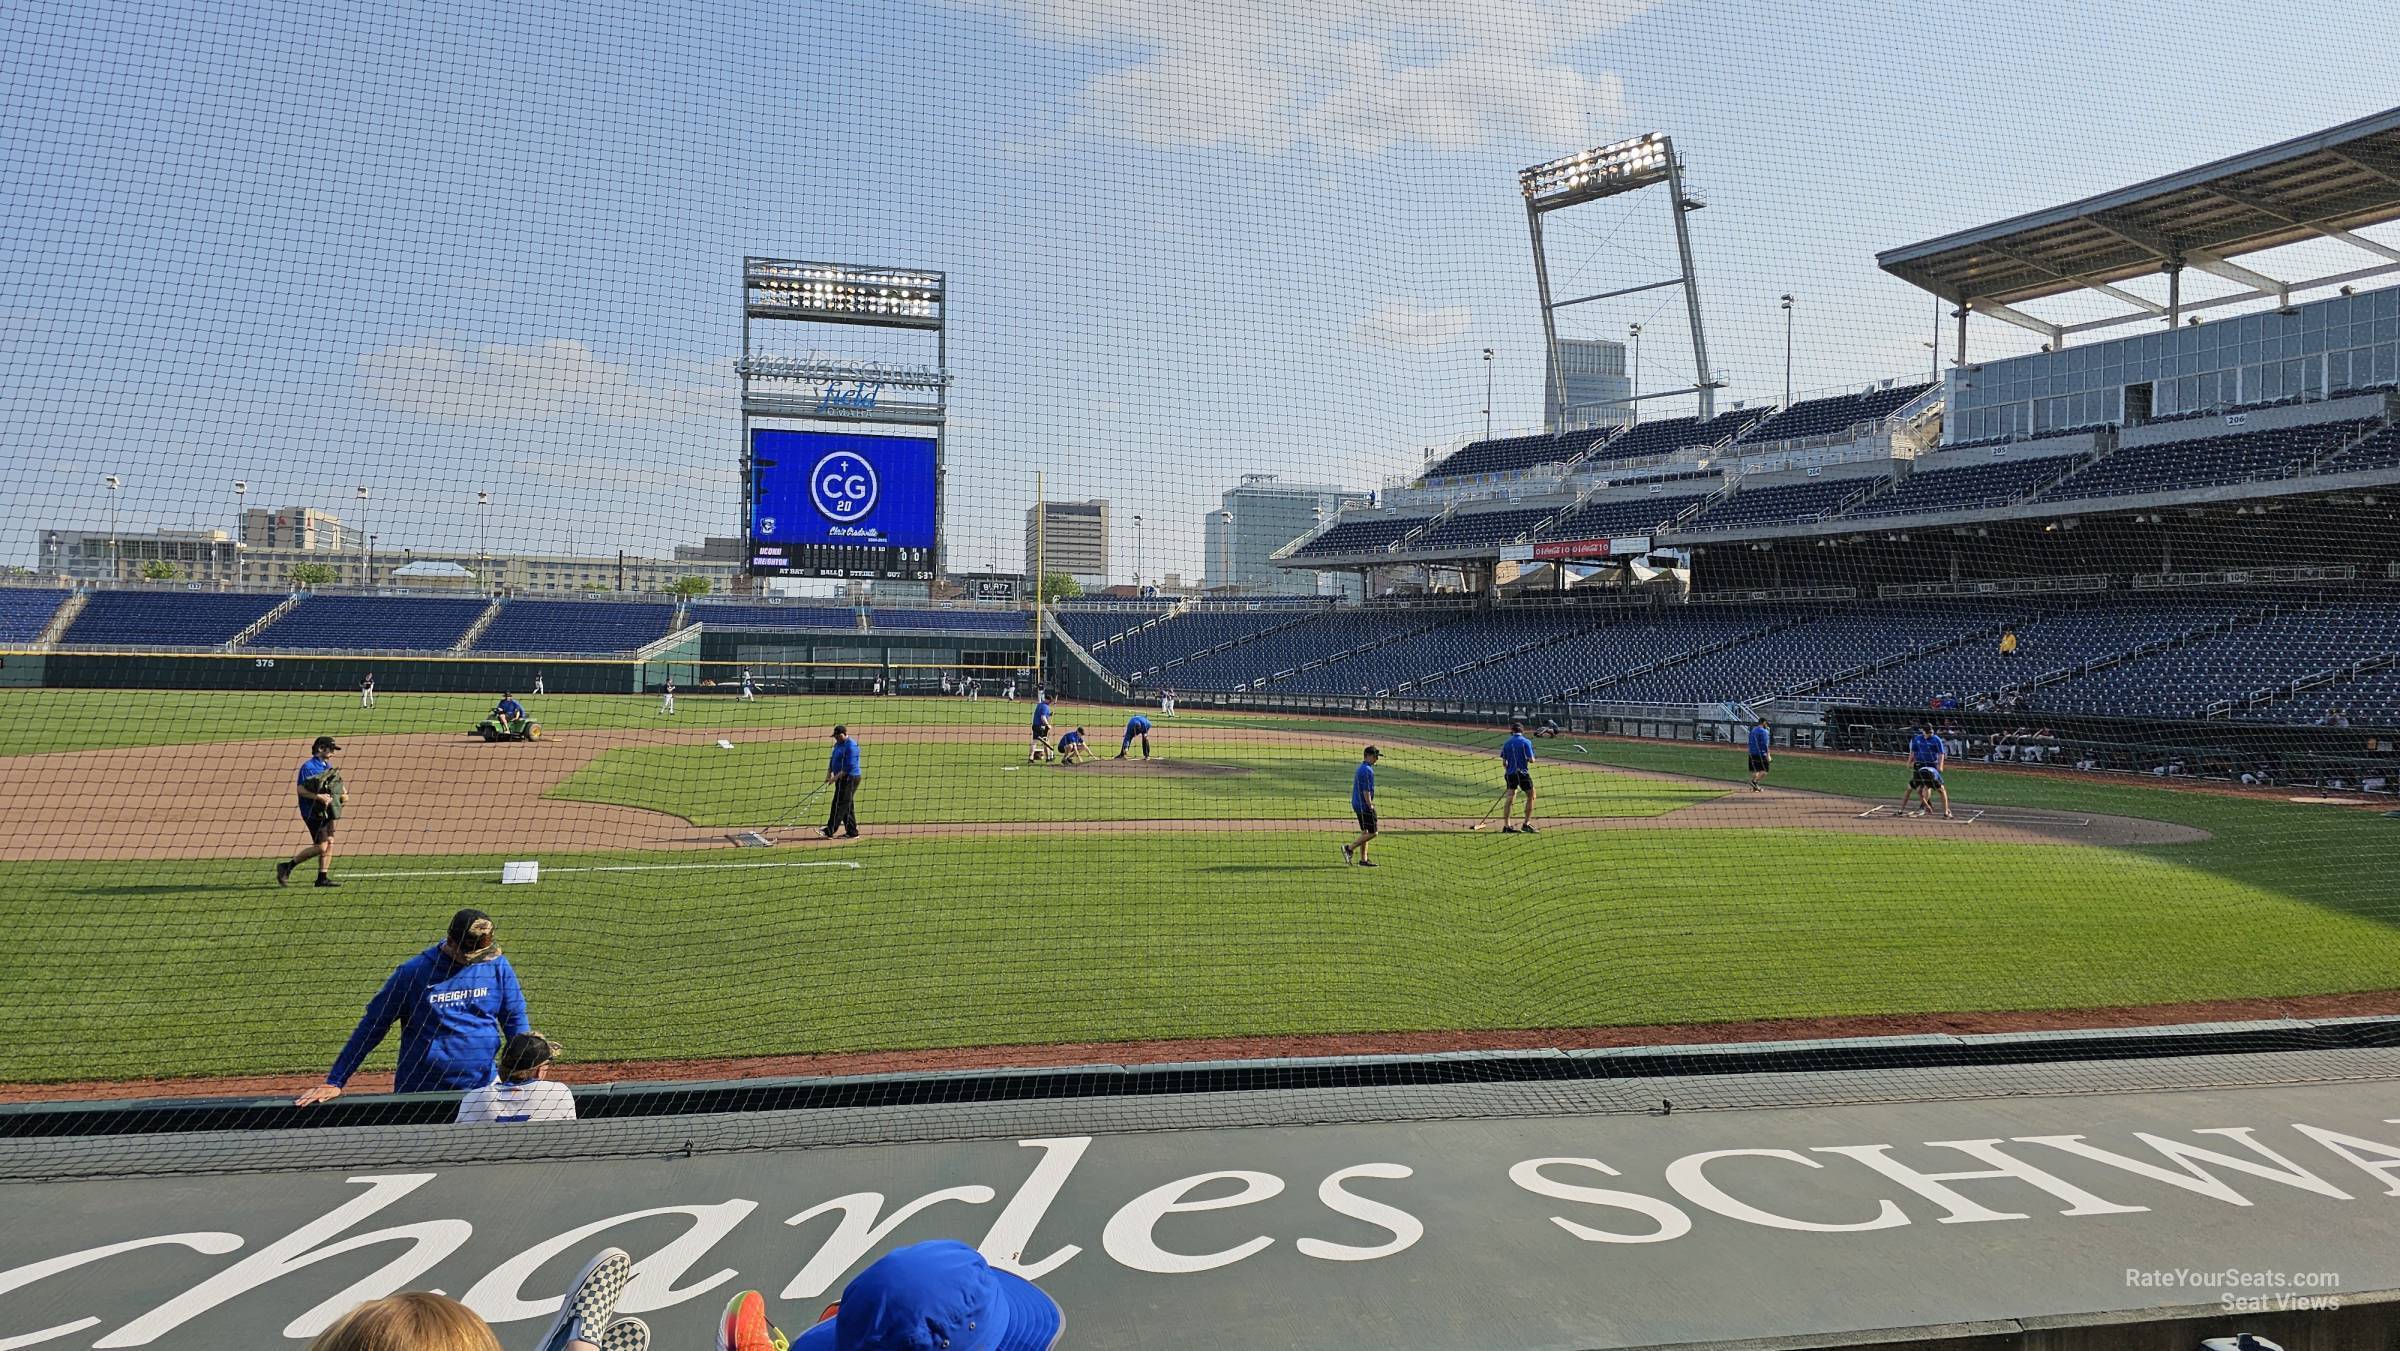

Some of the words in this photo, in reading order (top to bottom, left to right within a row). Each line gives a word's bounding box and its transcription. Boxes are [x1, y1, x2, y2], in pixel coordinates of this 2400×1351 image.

[815, 381, 880, 412] field
[826, 407, 873, 418] OMAHA
[2228, 416, 2245, 424] 206
[822, 474, 866, 500] CG
[836, 501, 852, 512] 20
[753, 557, 788, 566] CREIGHTON
[901, 552, 907, 560] 0
[914, 552, 920, 561] 0
[255, 659, 274, 668] 375
[1016, 668, 1030, 676] 335
[429, 987, 489, 1004] CREIGHTON
[1508, 1119, 2400, 1244] SCHWA
